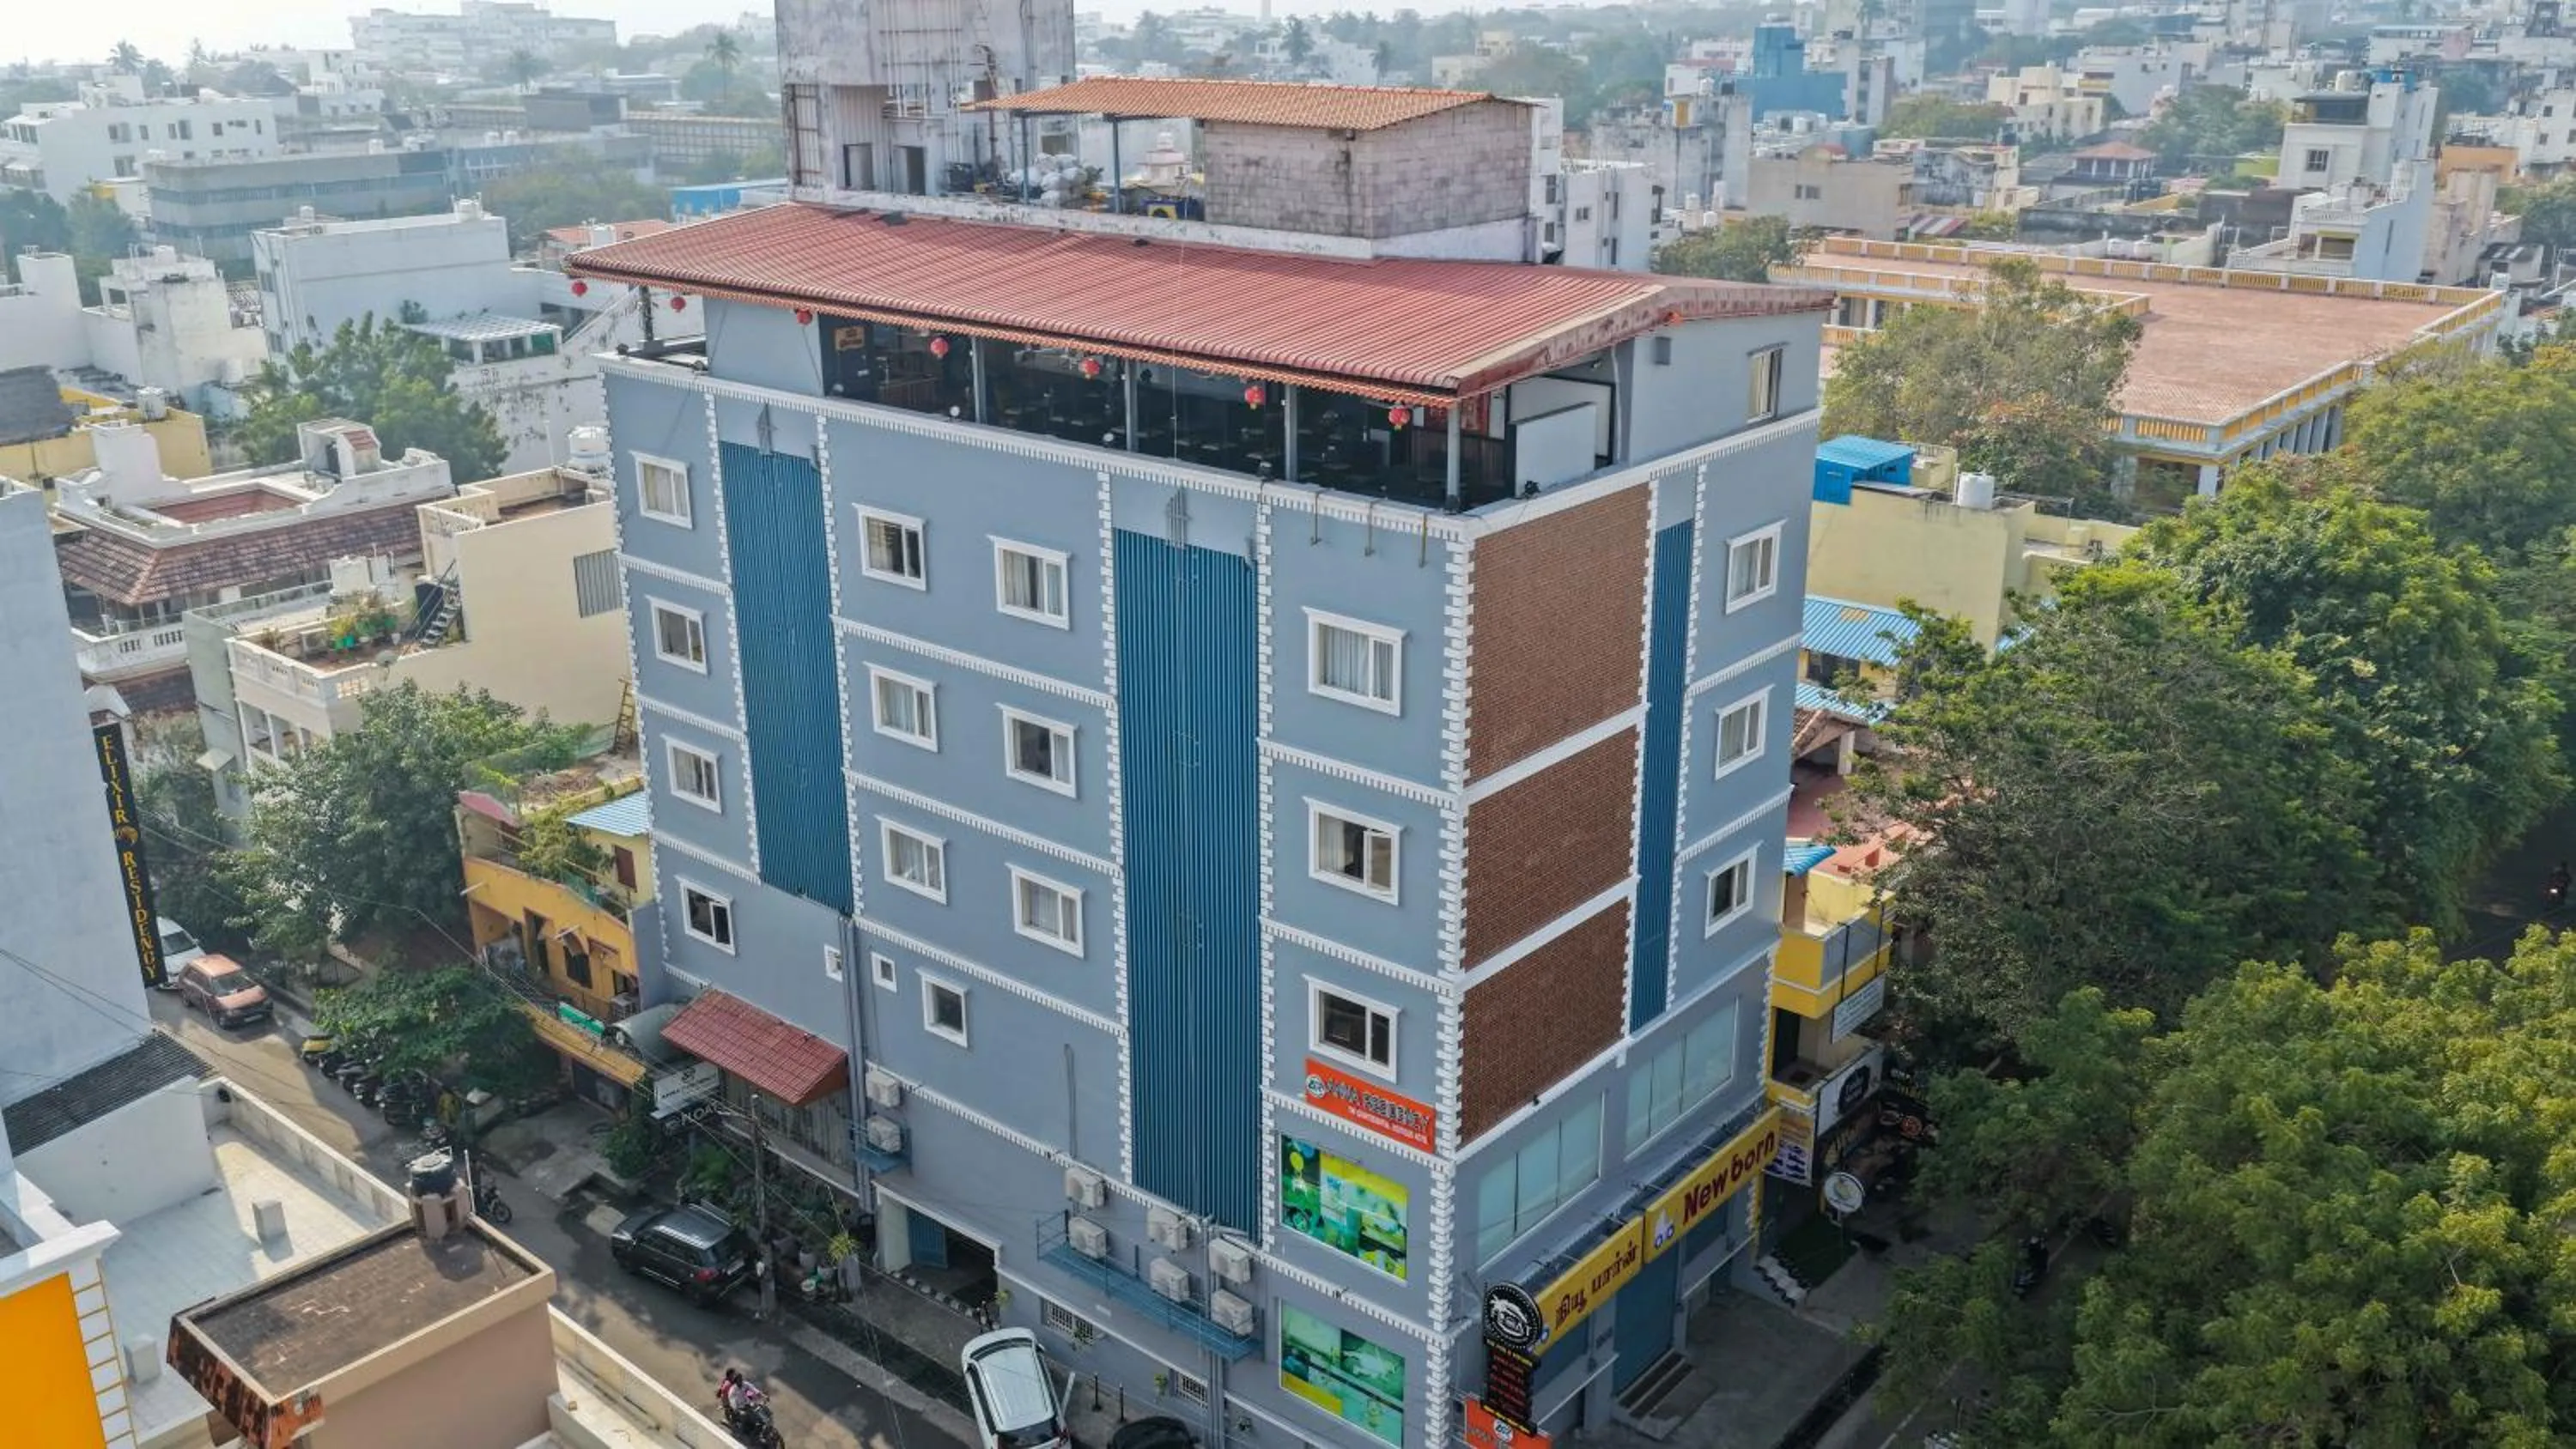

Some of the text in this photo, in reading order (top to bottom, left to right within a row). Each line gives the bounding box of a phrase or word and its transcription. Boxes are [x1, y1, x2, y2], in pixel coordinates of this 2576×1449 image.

[101, 734, 158, 980] ELIXIR RESIDENCY
[1682, 1169, 1728, 1226] New
[1729, 1130, 1776, 1183] born
